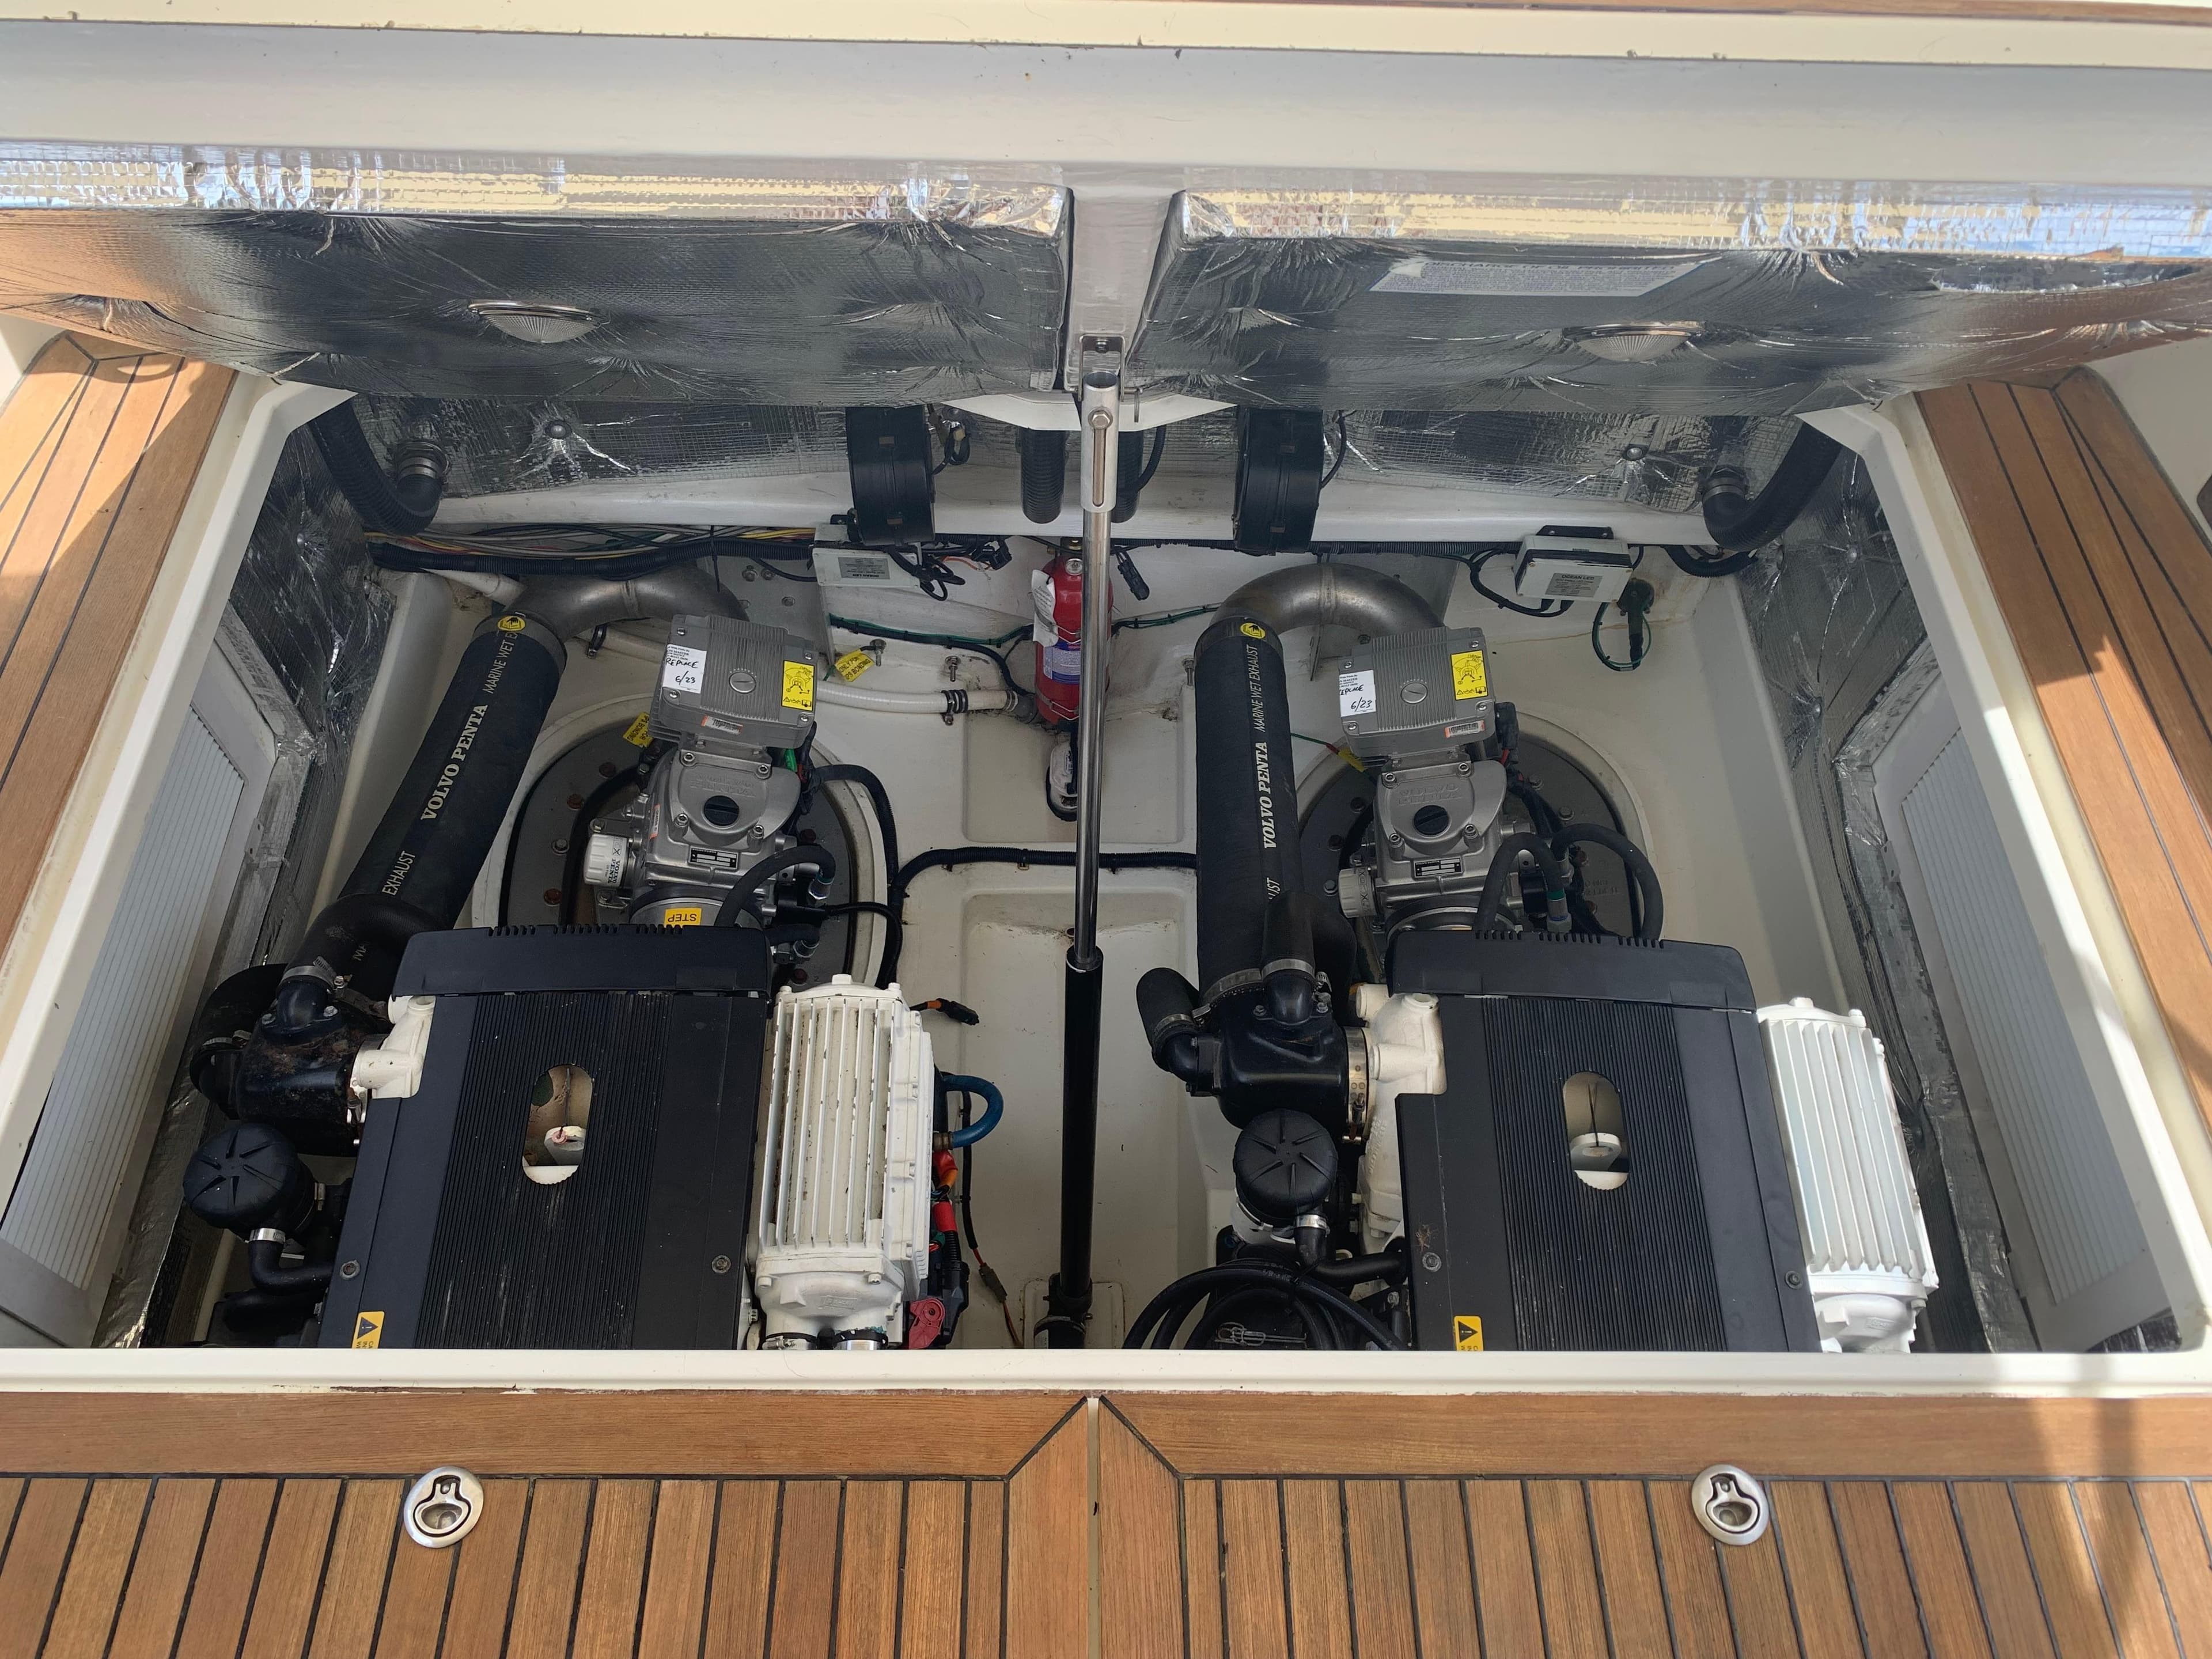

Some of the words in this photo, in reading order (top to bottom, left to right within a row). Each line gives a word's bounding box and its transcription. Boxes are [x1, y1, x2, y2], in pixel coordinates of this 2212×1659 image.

[482, 660, 507, 694] MARINE
[496, 639, 514, 658] WET
[666, 657, 699, 668] REPLACE
[839, 661, 851, 672] ONLY
[851, 659, 871, 674] BONDING
[1246, 645, 1259, 676] EXHAUST
[675, 671, 696, 685] 6/23
[1250, 676, 1262, 696] WET
[1252, 696, 1266, 732] MARINE
[1351, 696, 1372, 712] 6/23
[421, 763, 460, 821] VOLVO
[452, 703, 488, 763] PENTA
[1255, 741, 1271, 793] PENTA
[1260, 793, 1278, 849] VOLVO
[381, 850, 415, 896] EXHAUST
[608, 858, 616, 884] PENTA
[612, 859, 620, 884] VOLVO
[1267, 877, 1281, 899] UST
[668, 914, 697, 922] STEP
